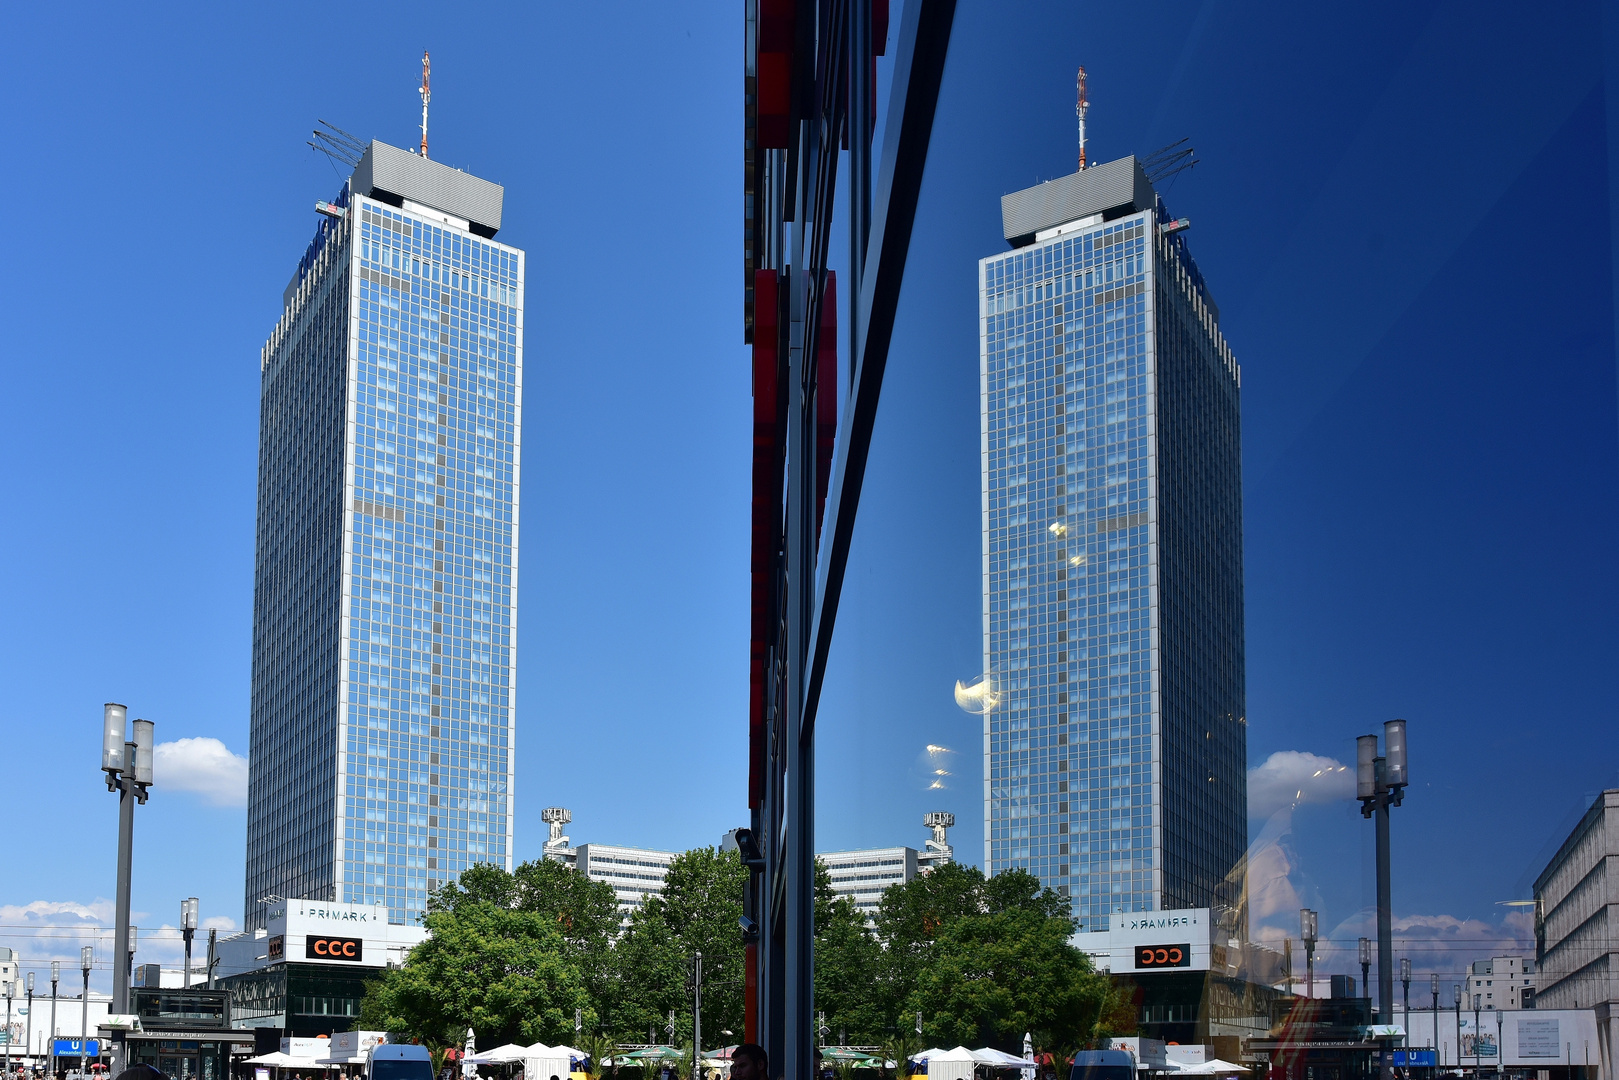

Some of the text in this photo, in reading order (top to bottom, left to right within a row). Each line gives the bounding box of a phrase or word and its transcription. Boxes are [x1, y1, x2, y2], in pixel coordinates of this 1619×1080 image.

[309, 909, 367, 922] PRIMARK
[314, 939, 356, 957] CCC
[71, 1041, 79, 1050] U
